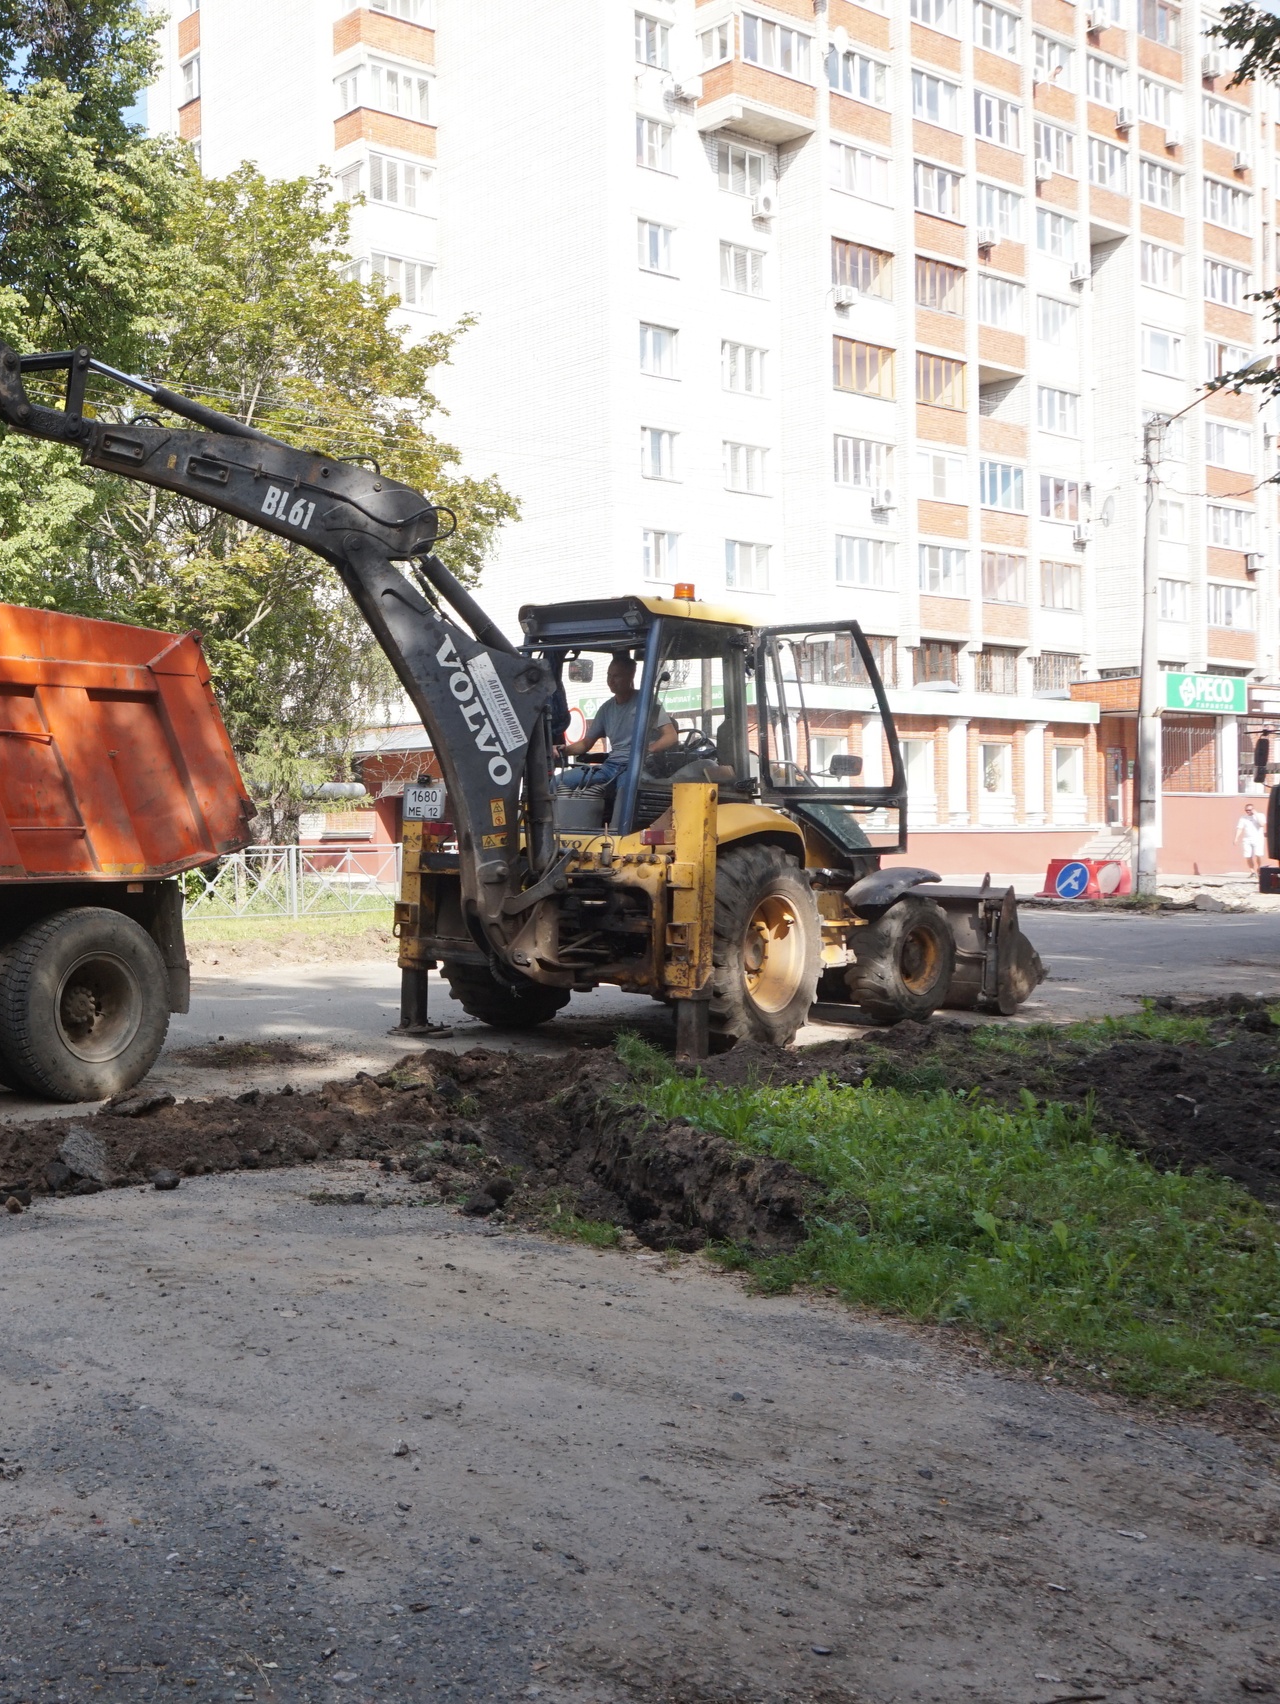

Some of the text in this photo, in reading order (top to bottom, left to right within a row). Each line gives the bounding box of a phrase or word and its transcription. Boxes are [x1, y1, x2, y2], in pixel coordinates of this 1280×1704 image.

[261, 485, 316, 530] BL61
[436, 633, 513, 785] VOLVO
[487, 678, 526, 745] АВТОТЕХИМПОРТ
[412, 790, 437, 802] 1680
[427, 807, 438, 817] 12
